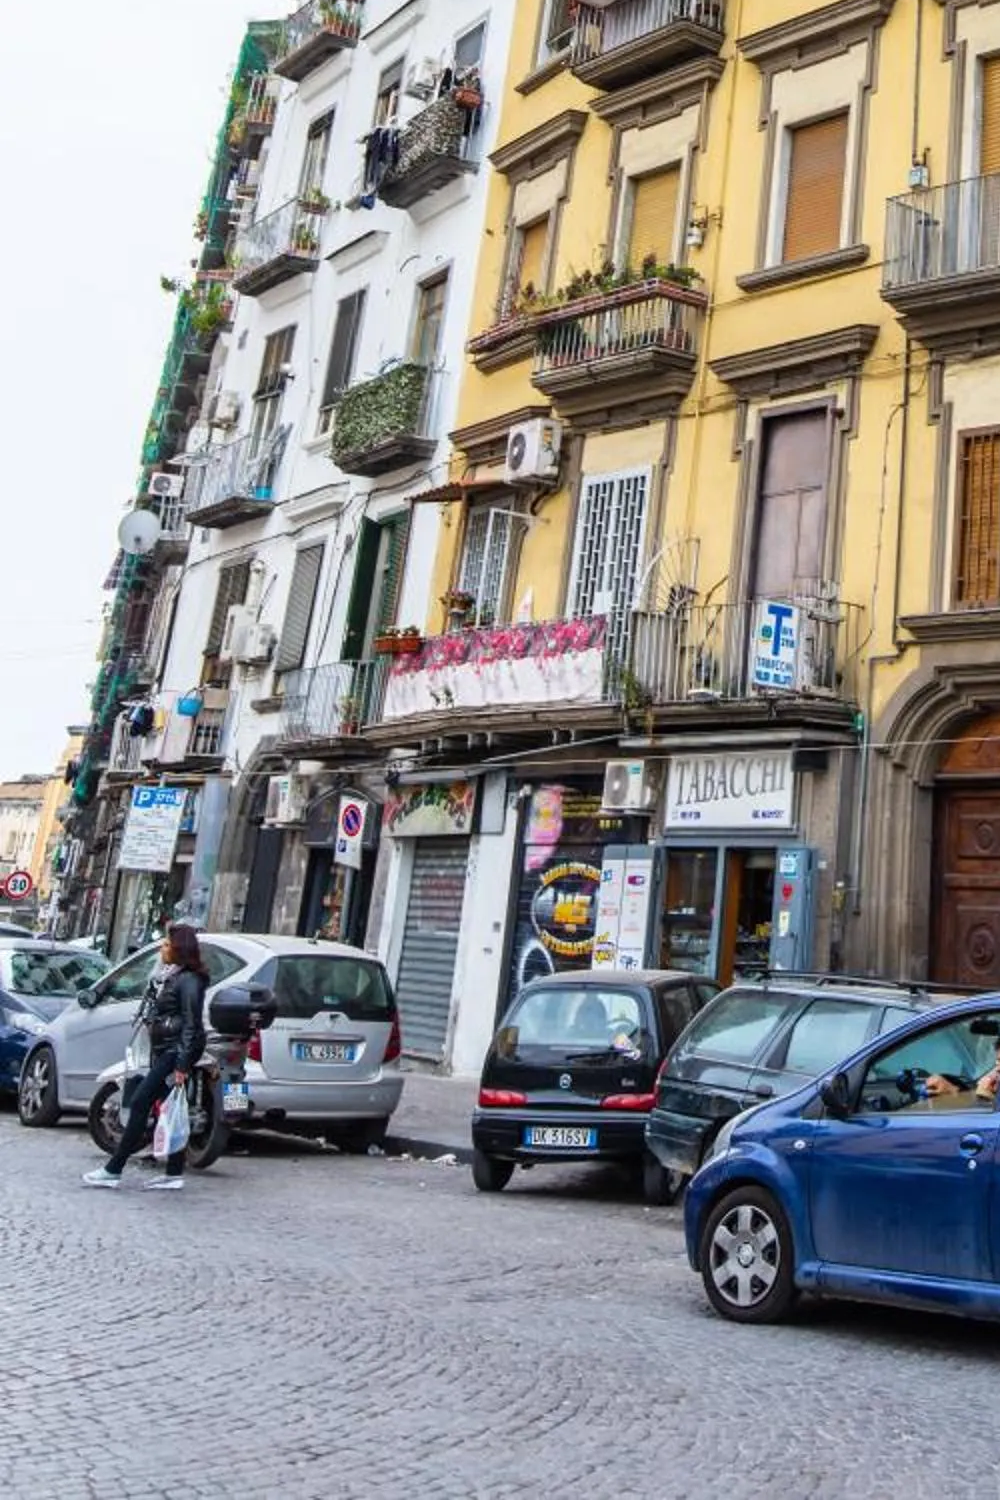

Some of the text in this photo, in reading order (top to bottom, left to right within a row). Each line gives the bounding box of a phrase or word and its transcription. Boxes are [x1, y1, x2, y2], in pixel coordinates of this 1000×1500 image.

[768, 604, 792, 656] T
[675, 756, 787, 806] TABACCHI
[11, 879, 27, 891] 30
